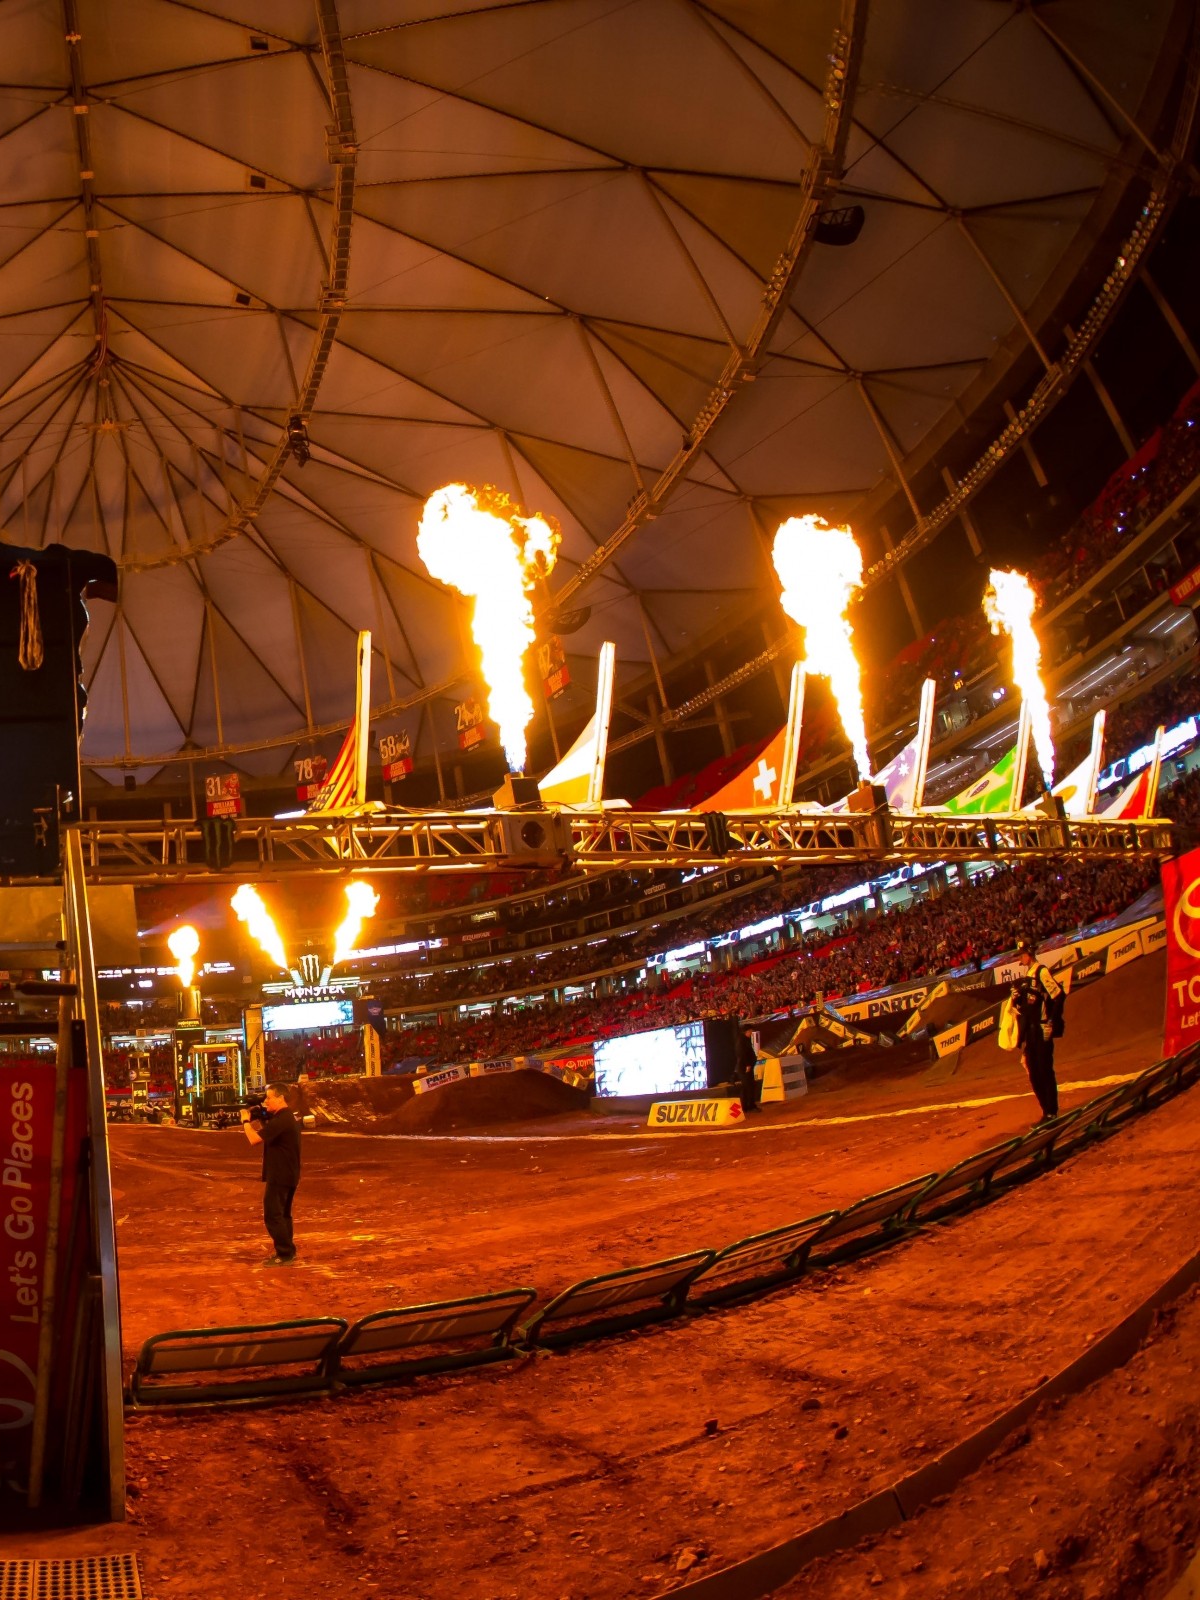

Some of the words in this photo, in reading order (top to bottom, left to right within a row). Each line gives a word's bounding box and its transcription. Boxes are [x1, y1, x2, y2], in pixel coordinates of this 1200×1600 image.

[379, 735, 396, 759] 58
[294, 758, 313, 781] 78
[206, 776, 221, 797] 31
[644, 883, 666, 895] verizon
[462, 931, 491, 942] EQUIFAX
[1113, 940, 1137, 960] THOR
[1077, 961, 1101, 980] THOR
[285, 985, 345, 998] MONSTER
[294, 996, 337, 1004] ENERGY
[868, 991, 925, 1018] PARTS
[971, 1016, 995, 1034] THOR
[940, 1033, 961, 1049] THOR
[178, 1054, 183, 1062] 2
[484, 1060, 512, 1070] PARTS
[178, 1067, 184, 1075] 3
[426, 1068, 459, 1084] PARTS
[179, 1089, 185, 1097] 5
[656, 1103, 718, 1123] SUZUKI
[2, 1081, 34, 1190] Places
[4, 1196, 35, 1240] Go
[8, 1250, 39, 1324] Let's
